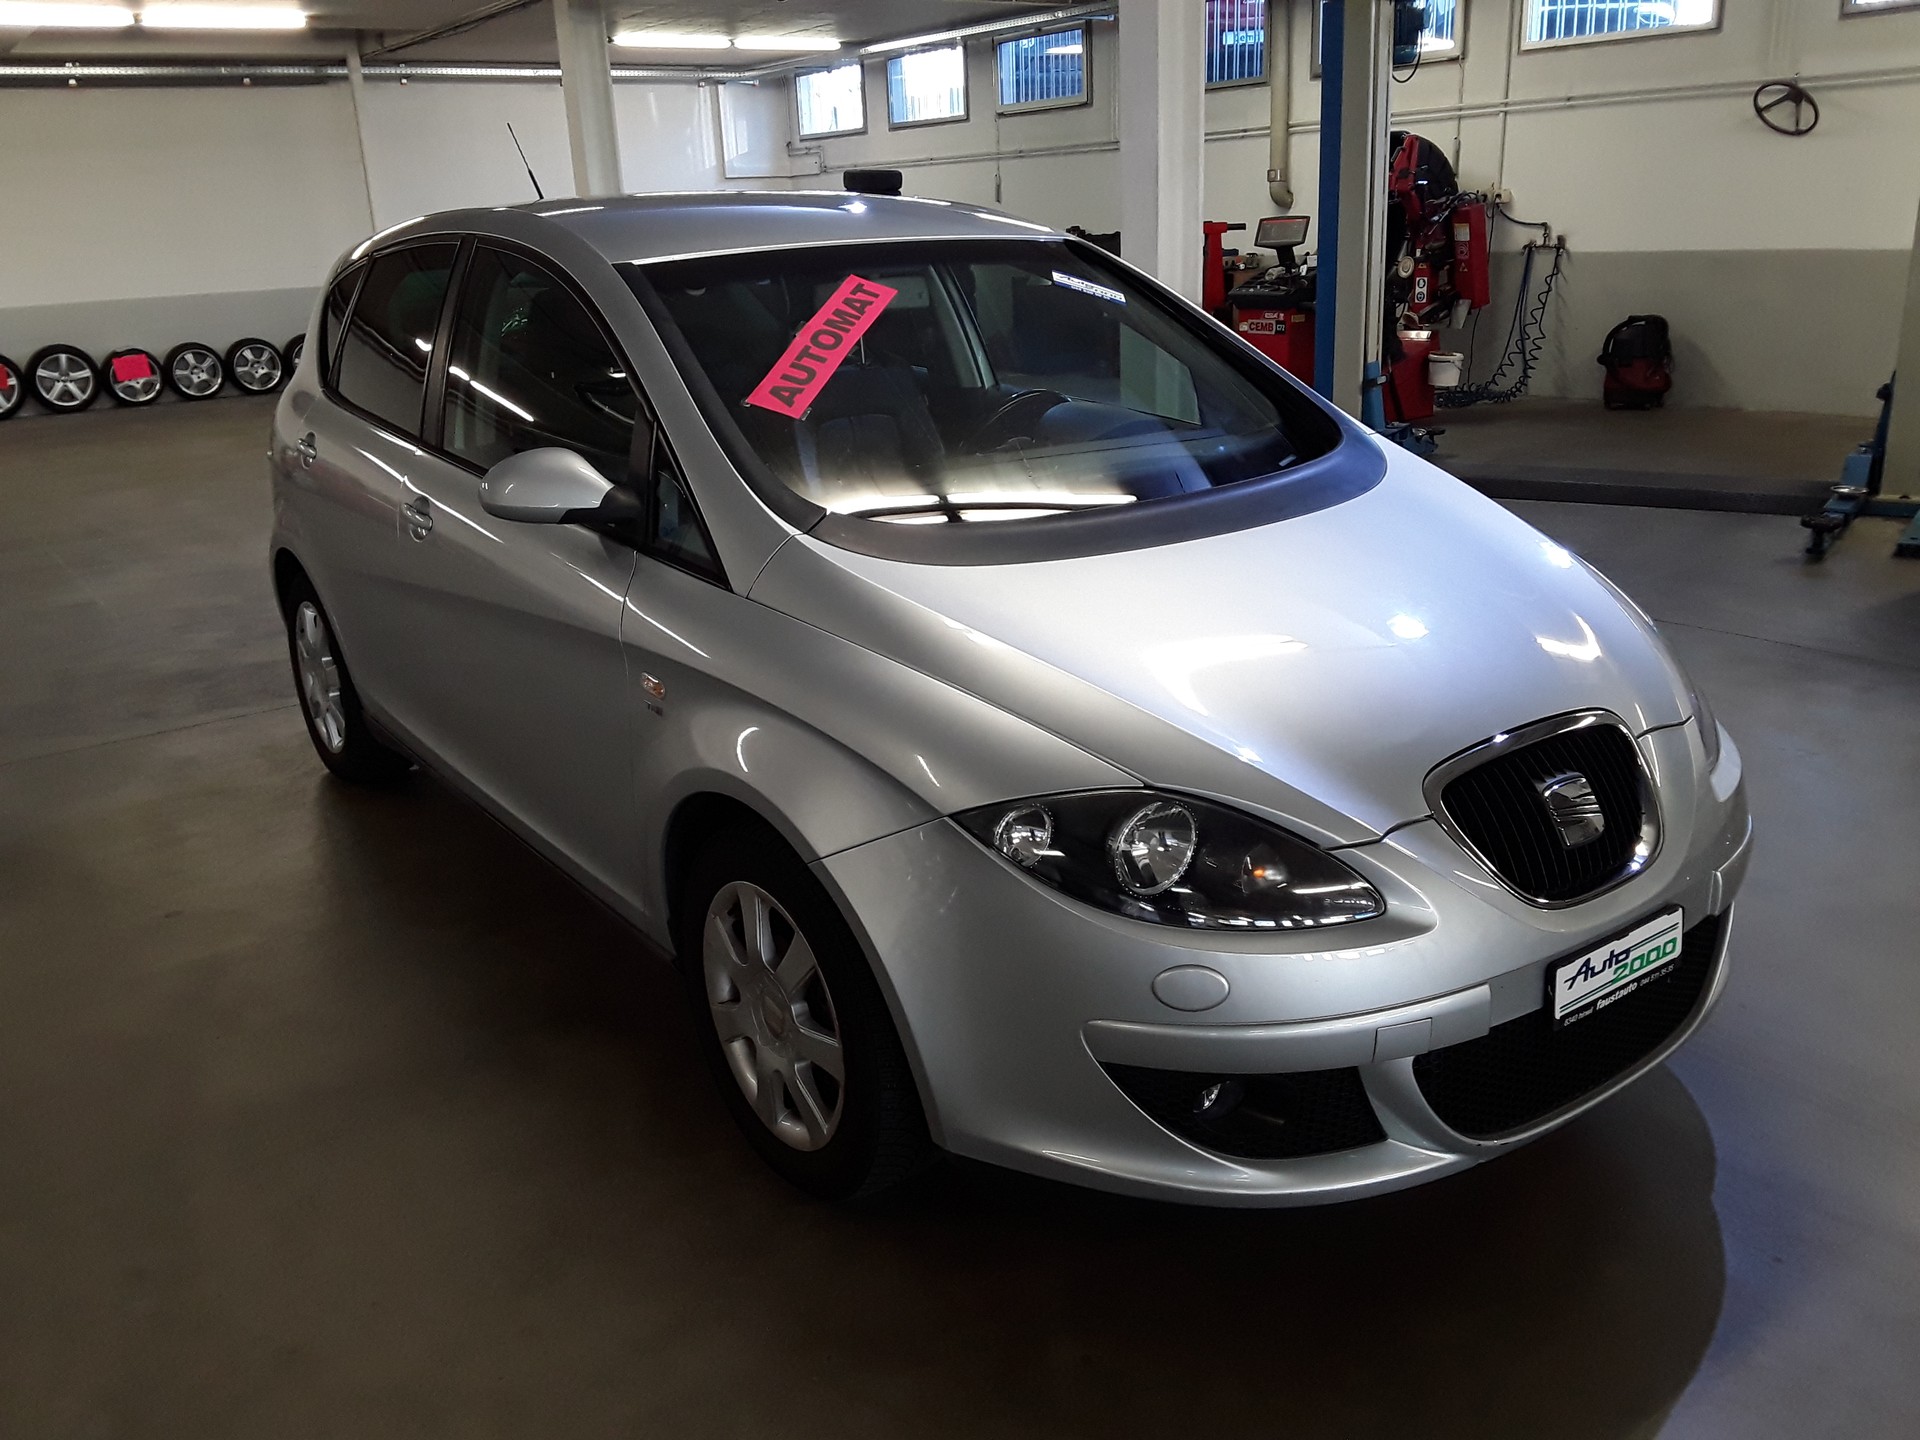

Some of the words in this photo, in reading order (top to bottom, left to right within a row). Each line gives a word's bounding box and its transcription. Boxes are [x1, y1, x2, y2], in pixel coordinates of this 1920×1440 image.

[768, 282, 881, 408] AUTOMAT
[1249, 321, 1275, 332] CEMB
[1563, 948, 1632, 991] Auto
[1611, 936, 1678, 985] 2000
